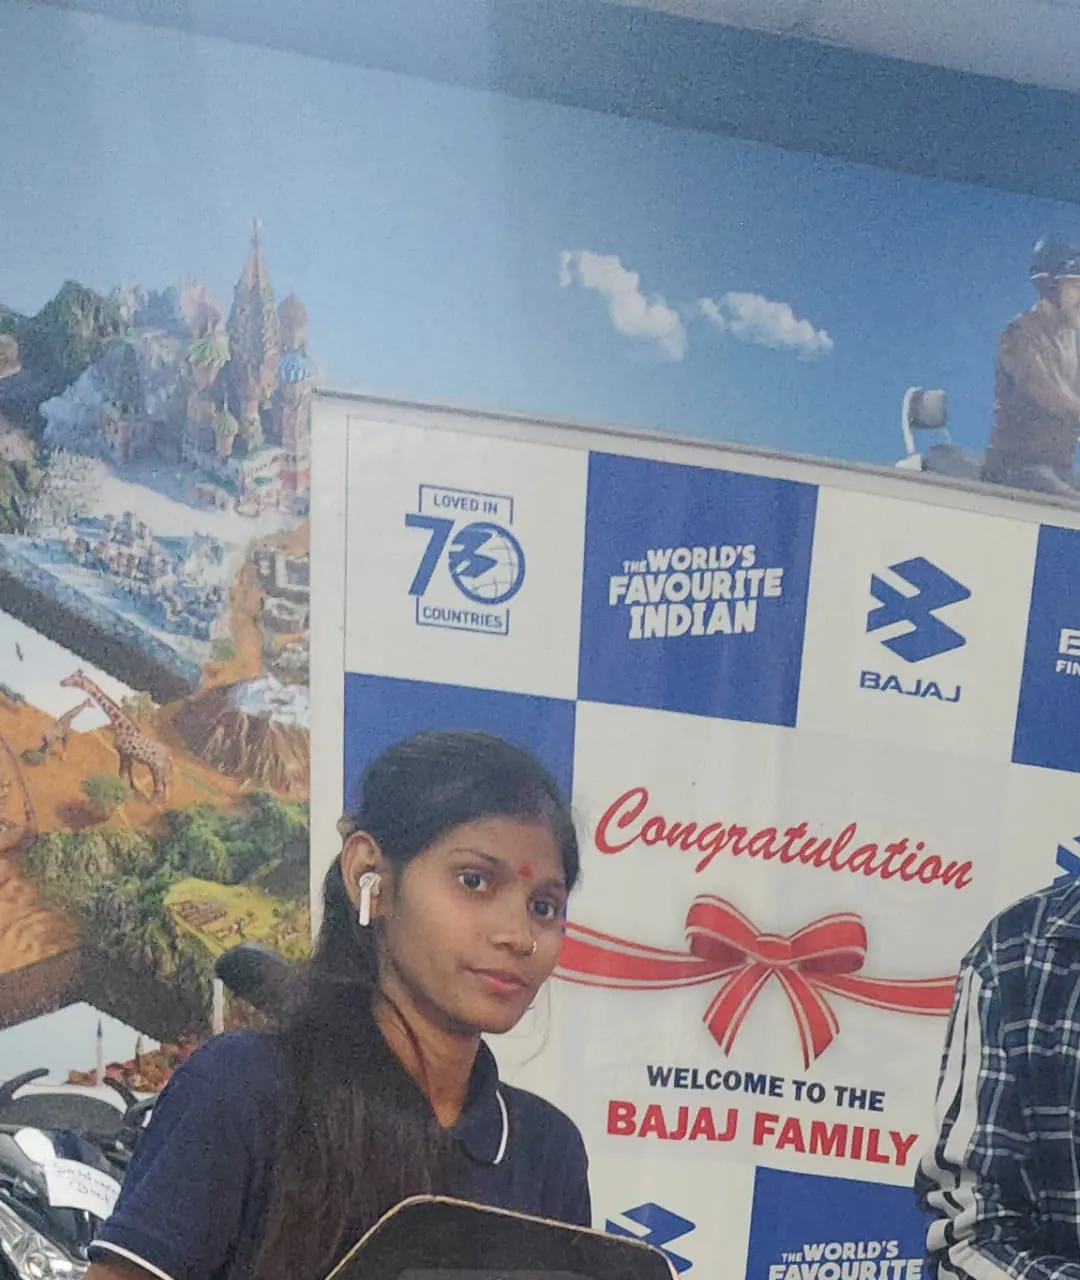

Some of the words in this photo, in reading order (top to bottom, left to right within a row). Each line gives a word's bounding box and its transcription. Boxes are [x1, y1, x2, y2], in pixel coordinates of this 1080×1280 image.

[433, 494, 480, 513] LOVED
[482, 501, 498, 514] IN
[622, 560, 648, 574] THE
[647, 544, 757, 572] WORLD'S
[608, 568, 784, 606] FAVOURITE
[422, 606, 503, 628] COUNTRIES
[628, 599, 758, 640] INDIAN
[859, 670, 962, 703] BAJAJ
[594, 786, 974, 889] Congratulation
[646, 1064, 785, 1098] WELCOME
[791, 1079, 826, 1105] TO
[834, 1085, 886, 1112] THE
[606, 1099, 739, 1142] BAJAJ
[752, 1111, 919, 1167] FAMILY
[781, 1252, 803, 1263] THE
[802, 1240, 899, 1262] WORLD'S
